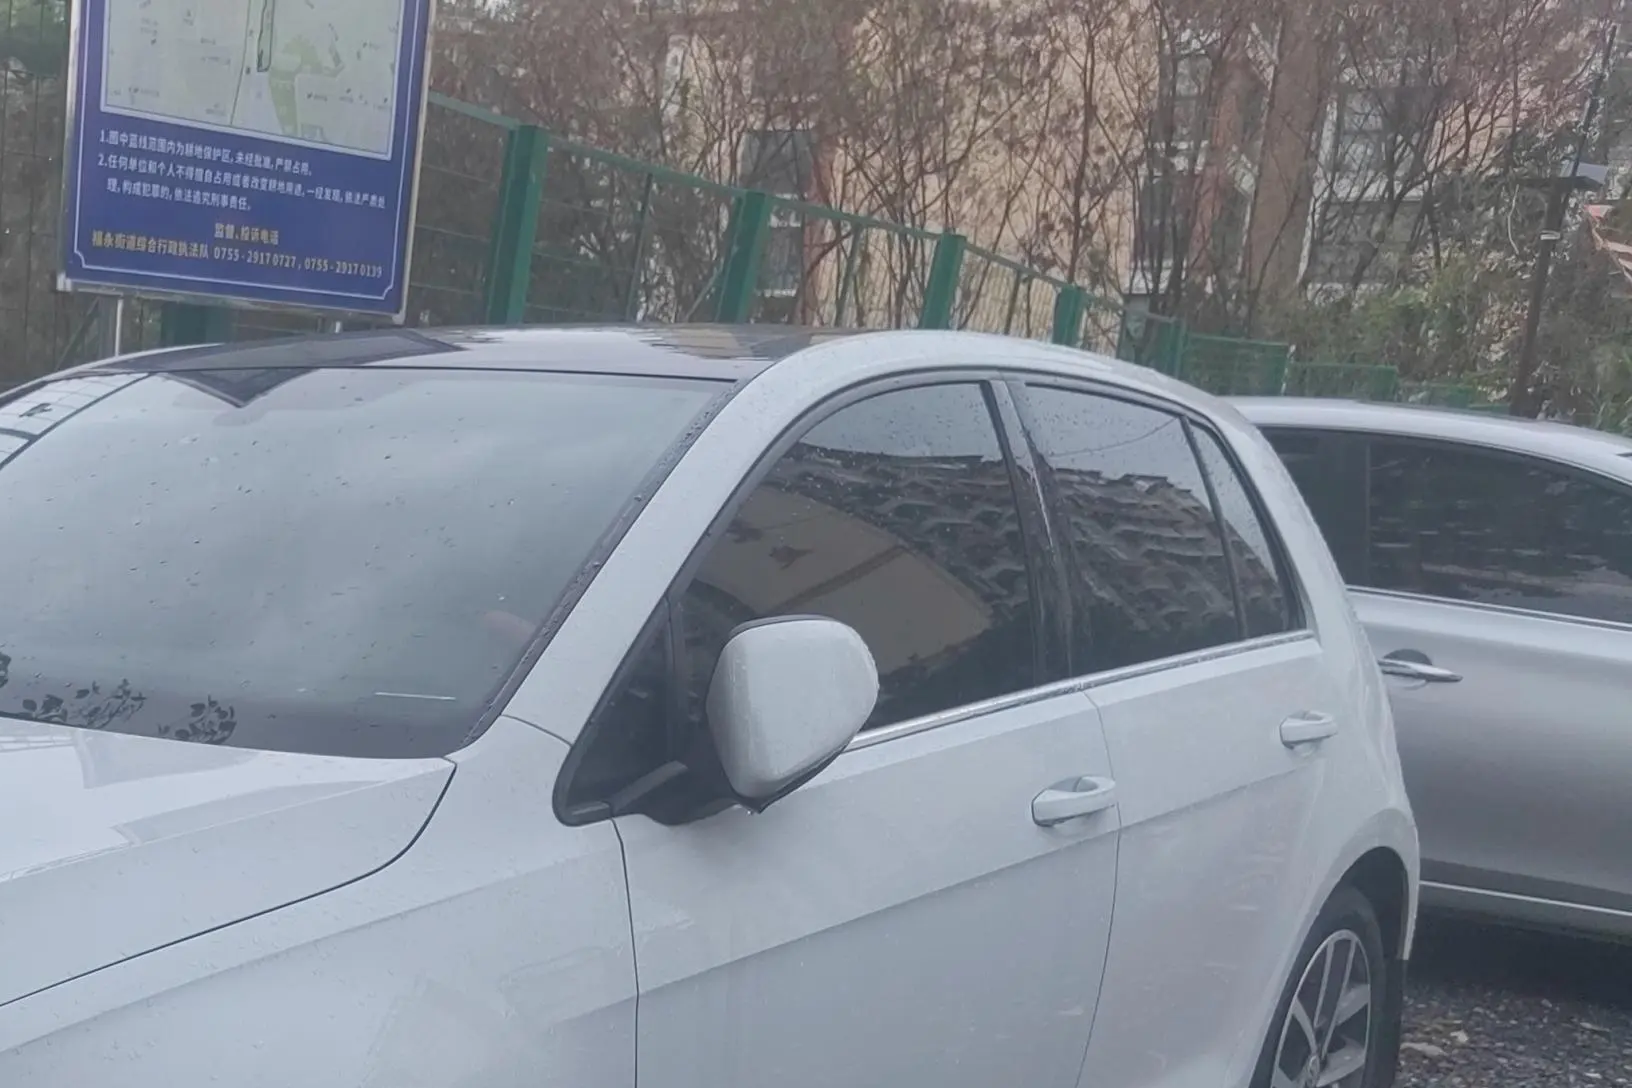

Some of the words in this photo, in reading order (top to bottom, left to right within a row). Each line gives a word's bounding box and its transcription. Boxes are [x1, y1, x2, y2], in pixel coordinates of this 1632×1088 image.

[91, 230, 209, 260] 福永街道综合行政执法队
